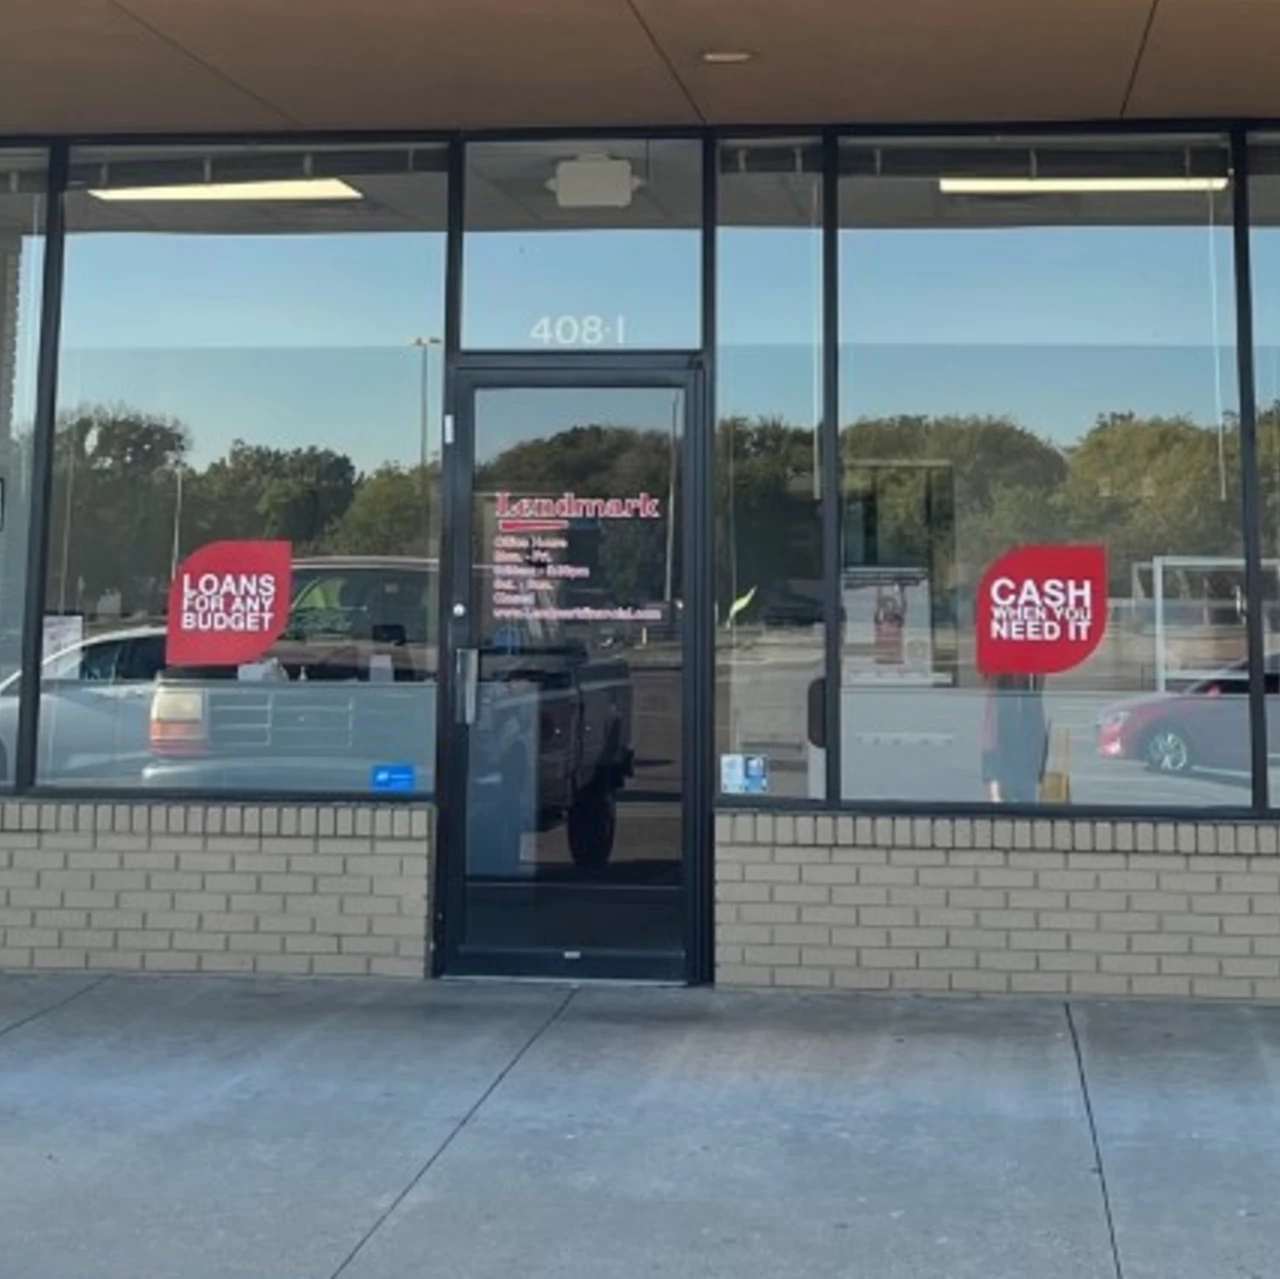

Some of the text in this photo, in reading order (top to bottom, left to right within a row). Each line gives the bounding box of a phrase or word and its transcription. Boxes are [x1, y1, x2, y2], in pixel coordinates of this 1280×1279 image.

[495, 492, 661, 518] Lendmark
[183, 573, 276, 596] LOANS
[990, 577, 1091, 607] CASH
[183, 595, 276, 612] FOR ANY
[991, 605, 1091, 621] WHEN YOU
[181, 612, 275, 632] BUDGET
[990, 621, 1092, 641] NEED IT
